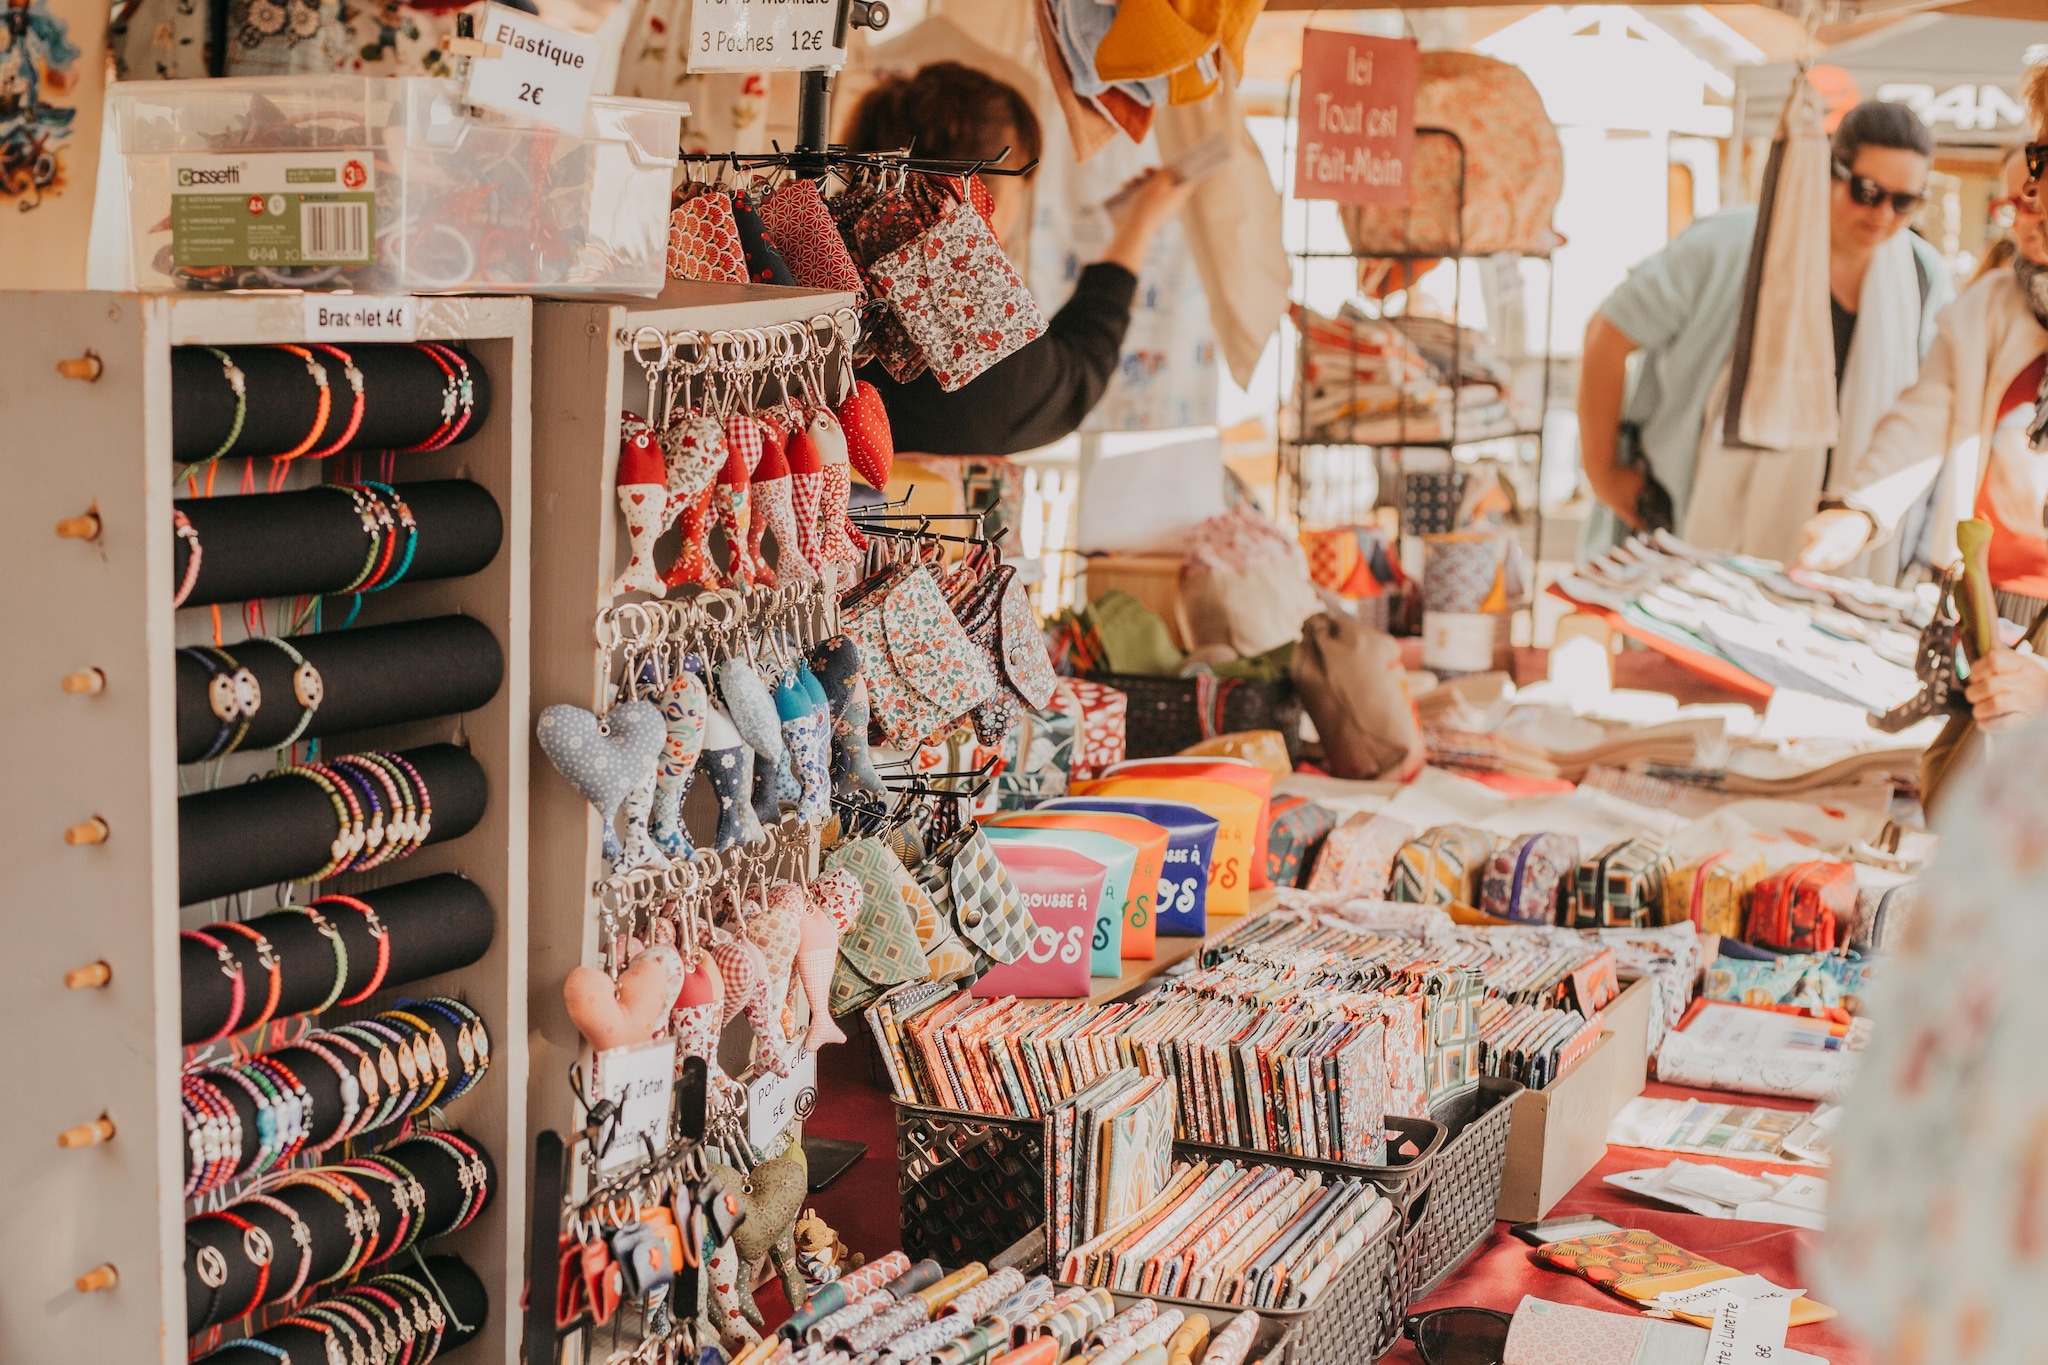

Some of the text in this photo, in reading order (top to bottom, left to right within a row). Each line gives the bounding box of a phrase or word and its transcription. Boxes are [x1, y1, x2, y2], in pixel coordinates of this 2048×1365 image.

[496, 24, 584, 69] Elastique
[701, 30, 824, 52] 3 Poches 12€
[1346, 46, 1374, 86] Ici
[518, 82, 544, 105] 2€
[1315, 91, 1398, 138] Tout est
[1020, 888, 1088, 911] ROUSSE À
[1027, 925, 1085, 964] OS
[773, 1097, 786, 1124] 5€
[1718, 1302, 1739, 1339] Lunette
[1755, 1344, 1772, 1359] 8€
